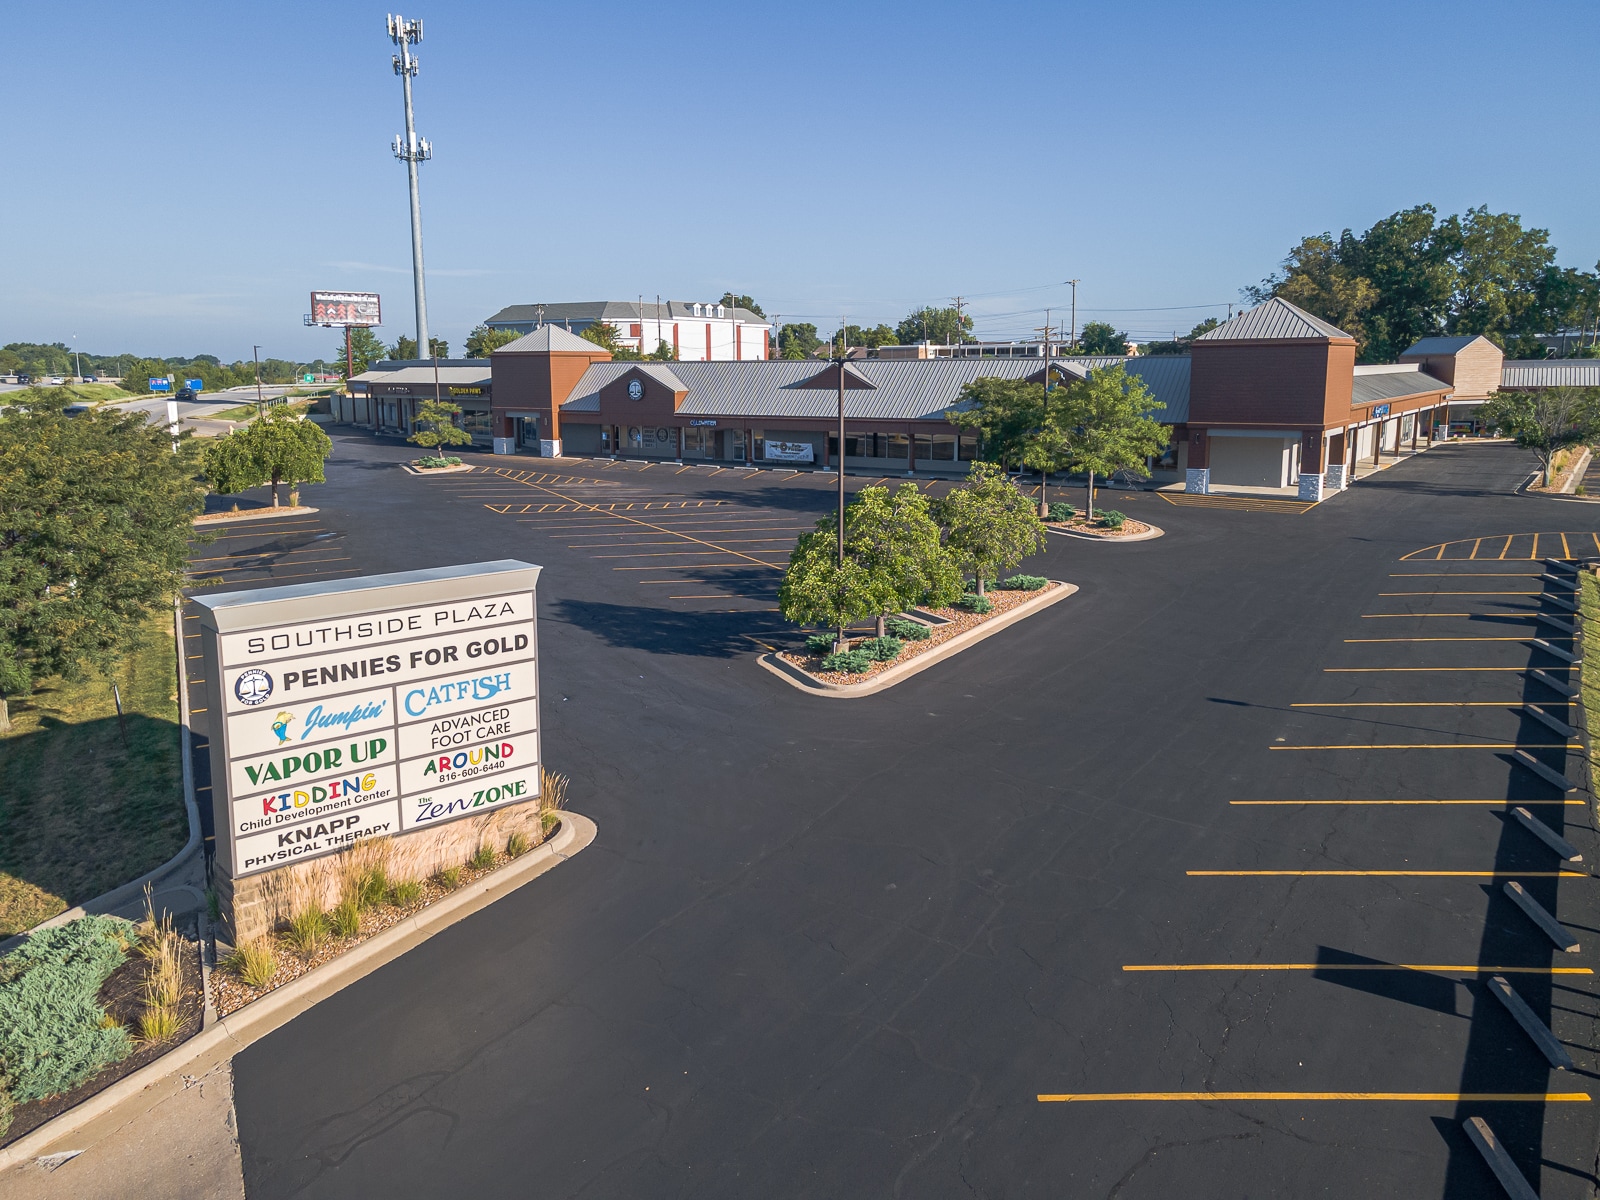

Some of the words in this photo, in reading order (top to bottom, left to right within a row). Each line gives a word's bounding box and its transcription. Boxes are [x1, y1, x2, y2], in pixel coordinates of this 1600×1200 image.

[248, 615, 422, 654] SOUTHSIDE
[434, 602, 514, 626] PLAZA
[241, 670, 266, 680] PENNIES
[284, 655, 401, 691] PENNIES
[410, 646, 458, 669] FOR
[466, 634, 528, 657] GOLD
[254, 694, 270, 704] GOLD
[404, 673, 511, 717] CATFISH
[301, 700, 386, 740] Jumpin'
[430, 708, 510, 735] ADVANCED
[432, 731, 472, 749] FOOT
[476, 722, 511, 742] CARE
[245, 748, 342, 786] VAPOR
[351, 738, 387, 763] UP
[424, 742, 514, 776] AROUND
[439, 760, 505, 782] 816-600-6440
[240, 814, 272, 832] Child
[276, 798, 351, 823] Development
[354, 788, 391, 804] Center
[262, 773, 376, 816] KIDDING
[418, 794, 432, 804] The
[245, 843, 320, 868] PHYSICAL
[325, 822, 391, 850] THERAPY
[278, 814, 360, 846] KNAPP
